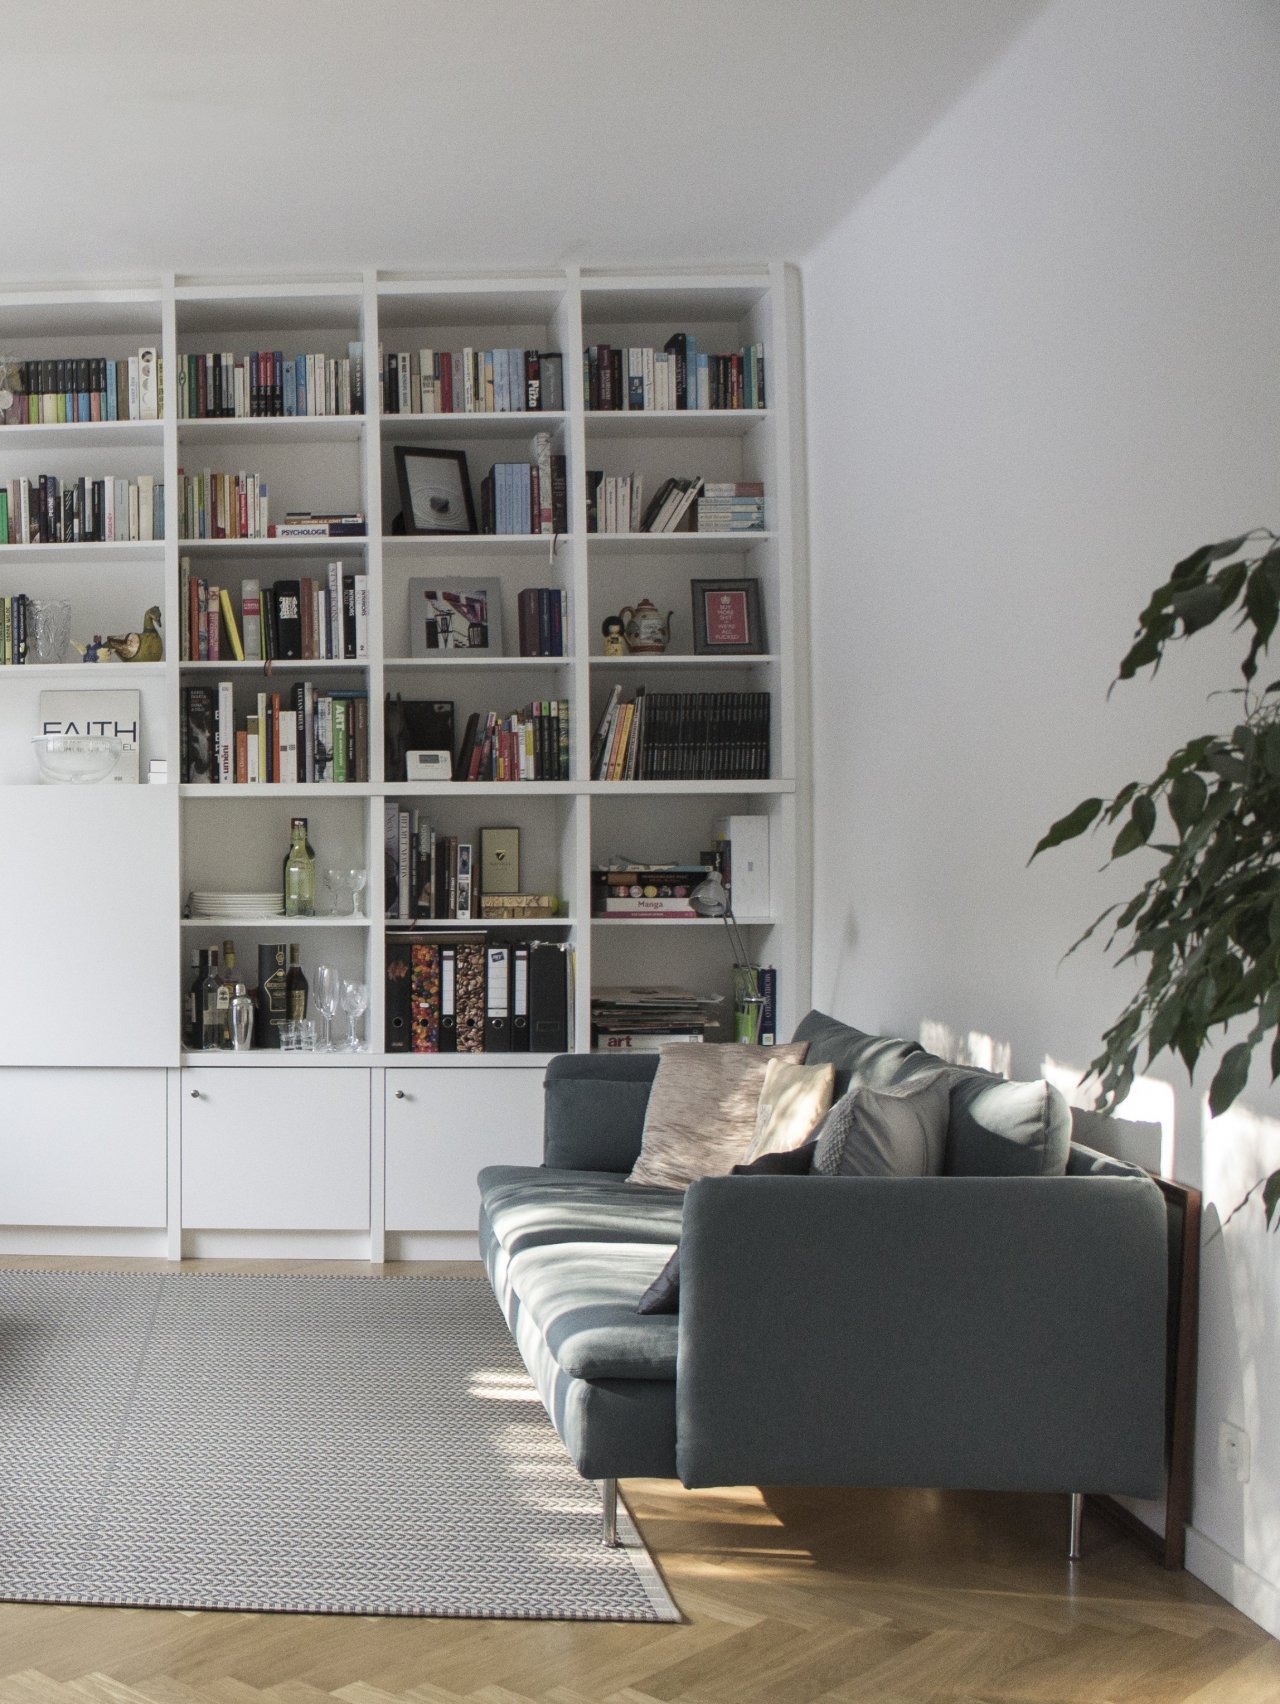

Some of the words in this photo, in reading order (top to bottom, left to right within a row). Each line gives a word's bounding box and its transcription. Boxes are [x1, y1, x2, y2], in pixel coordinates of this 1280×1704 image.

[335, 704, 345, 731] ART
[43, 721, 137, 743] FAITH
[401, 815, 409, 846] HELMUT
[401, 847, 409, 878] NEWTON
[637, 900, 664, 908] Manga
[764, 973, 772, 1018] MICHELANGELO
[607, 1035, 632, 1047] art
